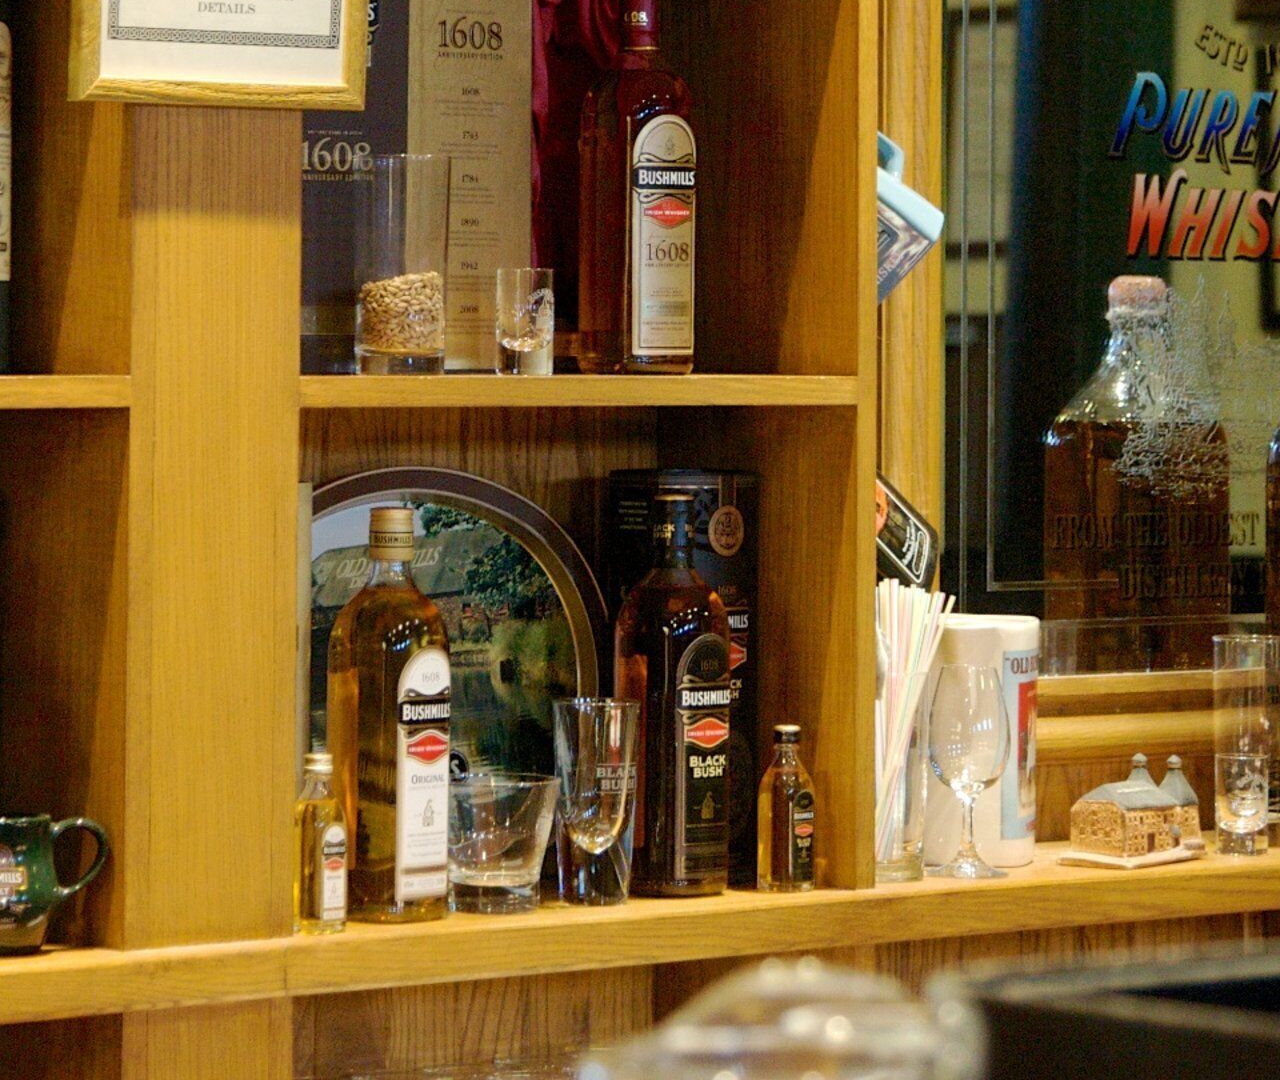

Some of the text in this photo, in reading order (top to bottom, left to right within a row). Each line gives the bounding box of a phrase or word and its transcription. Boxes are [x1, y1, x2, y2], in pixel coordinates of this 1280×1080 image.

[197, 1, 257, 15] DETAILS
[437, 15, 504, 53] 1608
[1194, 23, 1250, 73] ESTD
[438, 50, 504, 62] ANNIVERSARY EDITION
[461, 87, 480, 97] 1608
[1108, 70, 1277, 176] PURE
[301, 137, 373, 172] 1608
[638, 168, 696, 188] BUSHMILLS
[644, 209, 663, 217] IRISH
[645, 240, 690, 263] 1608
[459, 304, 480, 314] 2008
[699, 658, 720, 672] 1608
[421, 671, 441, 683] 1608
[681, 687, 731, 708] BUSHMILLS
[402, 702, 451, 721] BUSHMILLS
[689, 754, 727, 770] BLACK
[411, 772, 446, 786] ORIGINAL
[692, 765, 725, 780] BUSH
